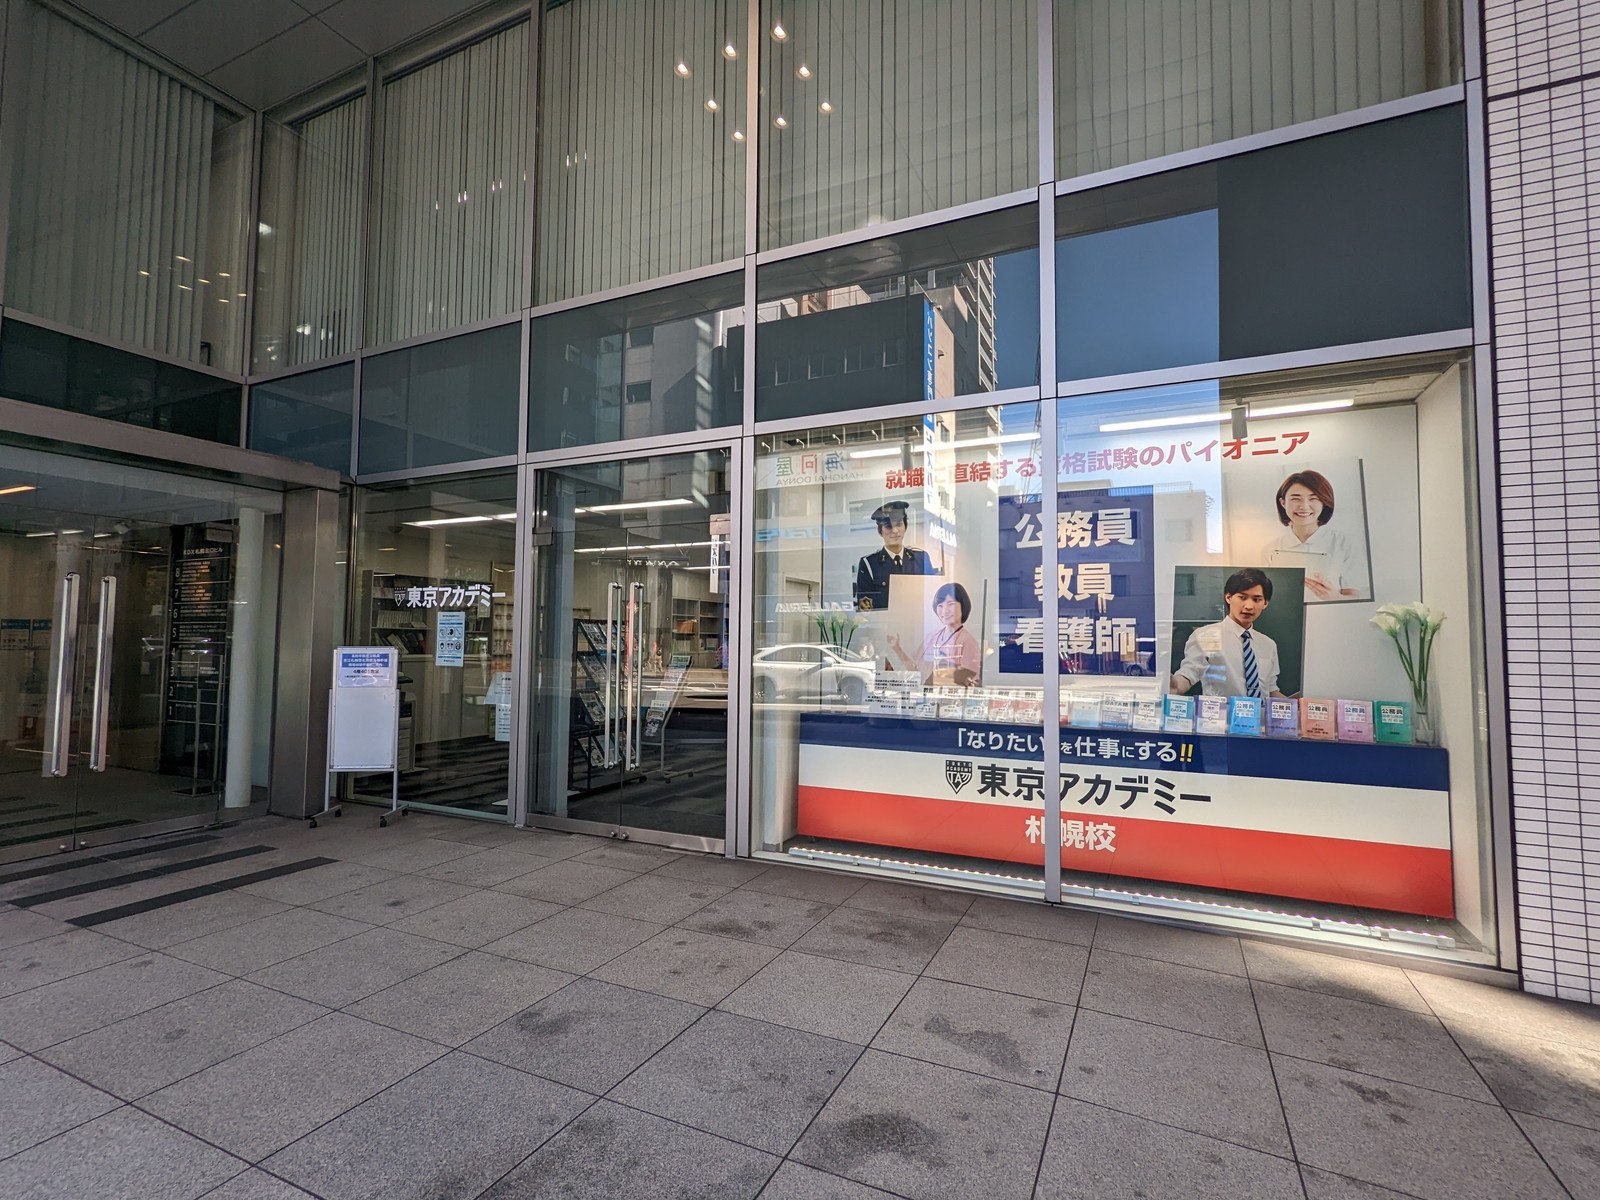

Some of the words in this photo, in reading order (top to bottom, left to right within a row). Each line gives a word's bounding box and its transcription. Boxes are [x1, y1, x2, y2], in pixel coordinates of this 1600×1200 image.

[1015, 508, 1136, 549] 公務員
[407, 584, 506, 609] 東京アカデミー
[1015, 616, 1137, 655] 看護師
[957, 727, 1194, 763] 「なりたいを仕事にする!!
[977, 763, 1212, 815] 東京アカデミー
[1025, 815, 1117, 853] 札幌校
